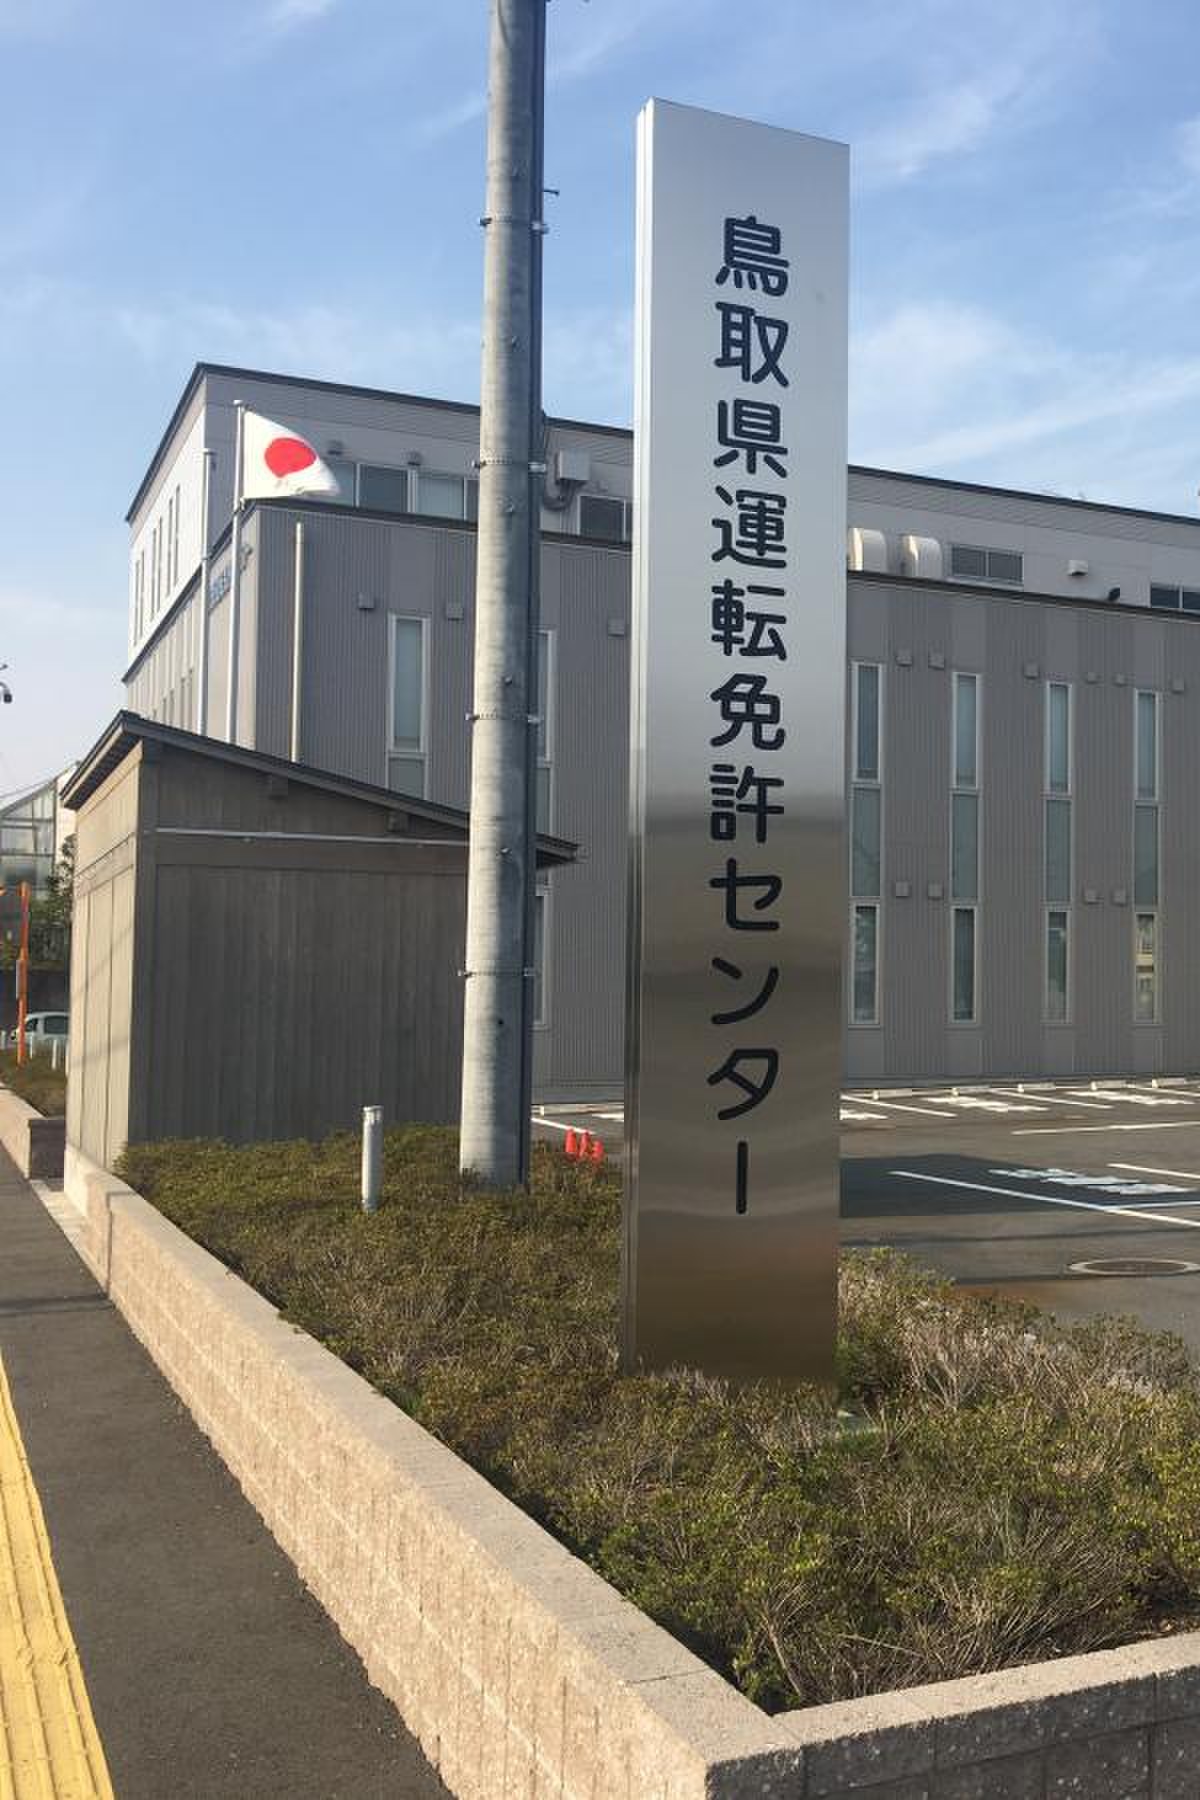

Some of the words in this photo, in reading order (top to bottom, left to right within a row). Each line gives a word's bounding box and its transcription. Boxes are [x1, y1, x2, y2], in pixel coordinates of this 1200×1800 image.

[707, 215, 790, 1216] 鳥取県運転免許センター
